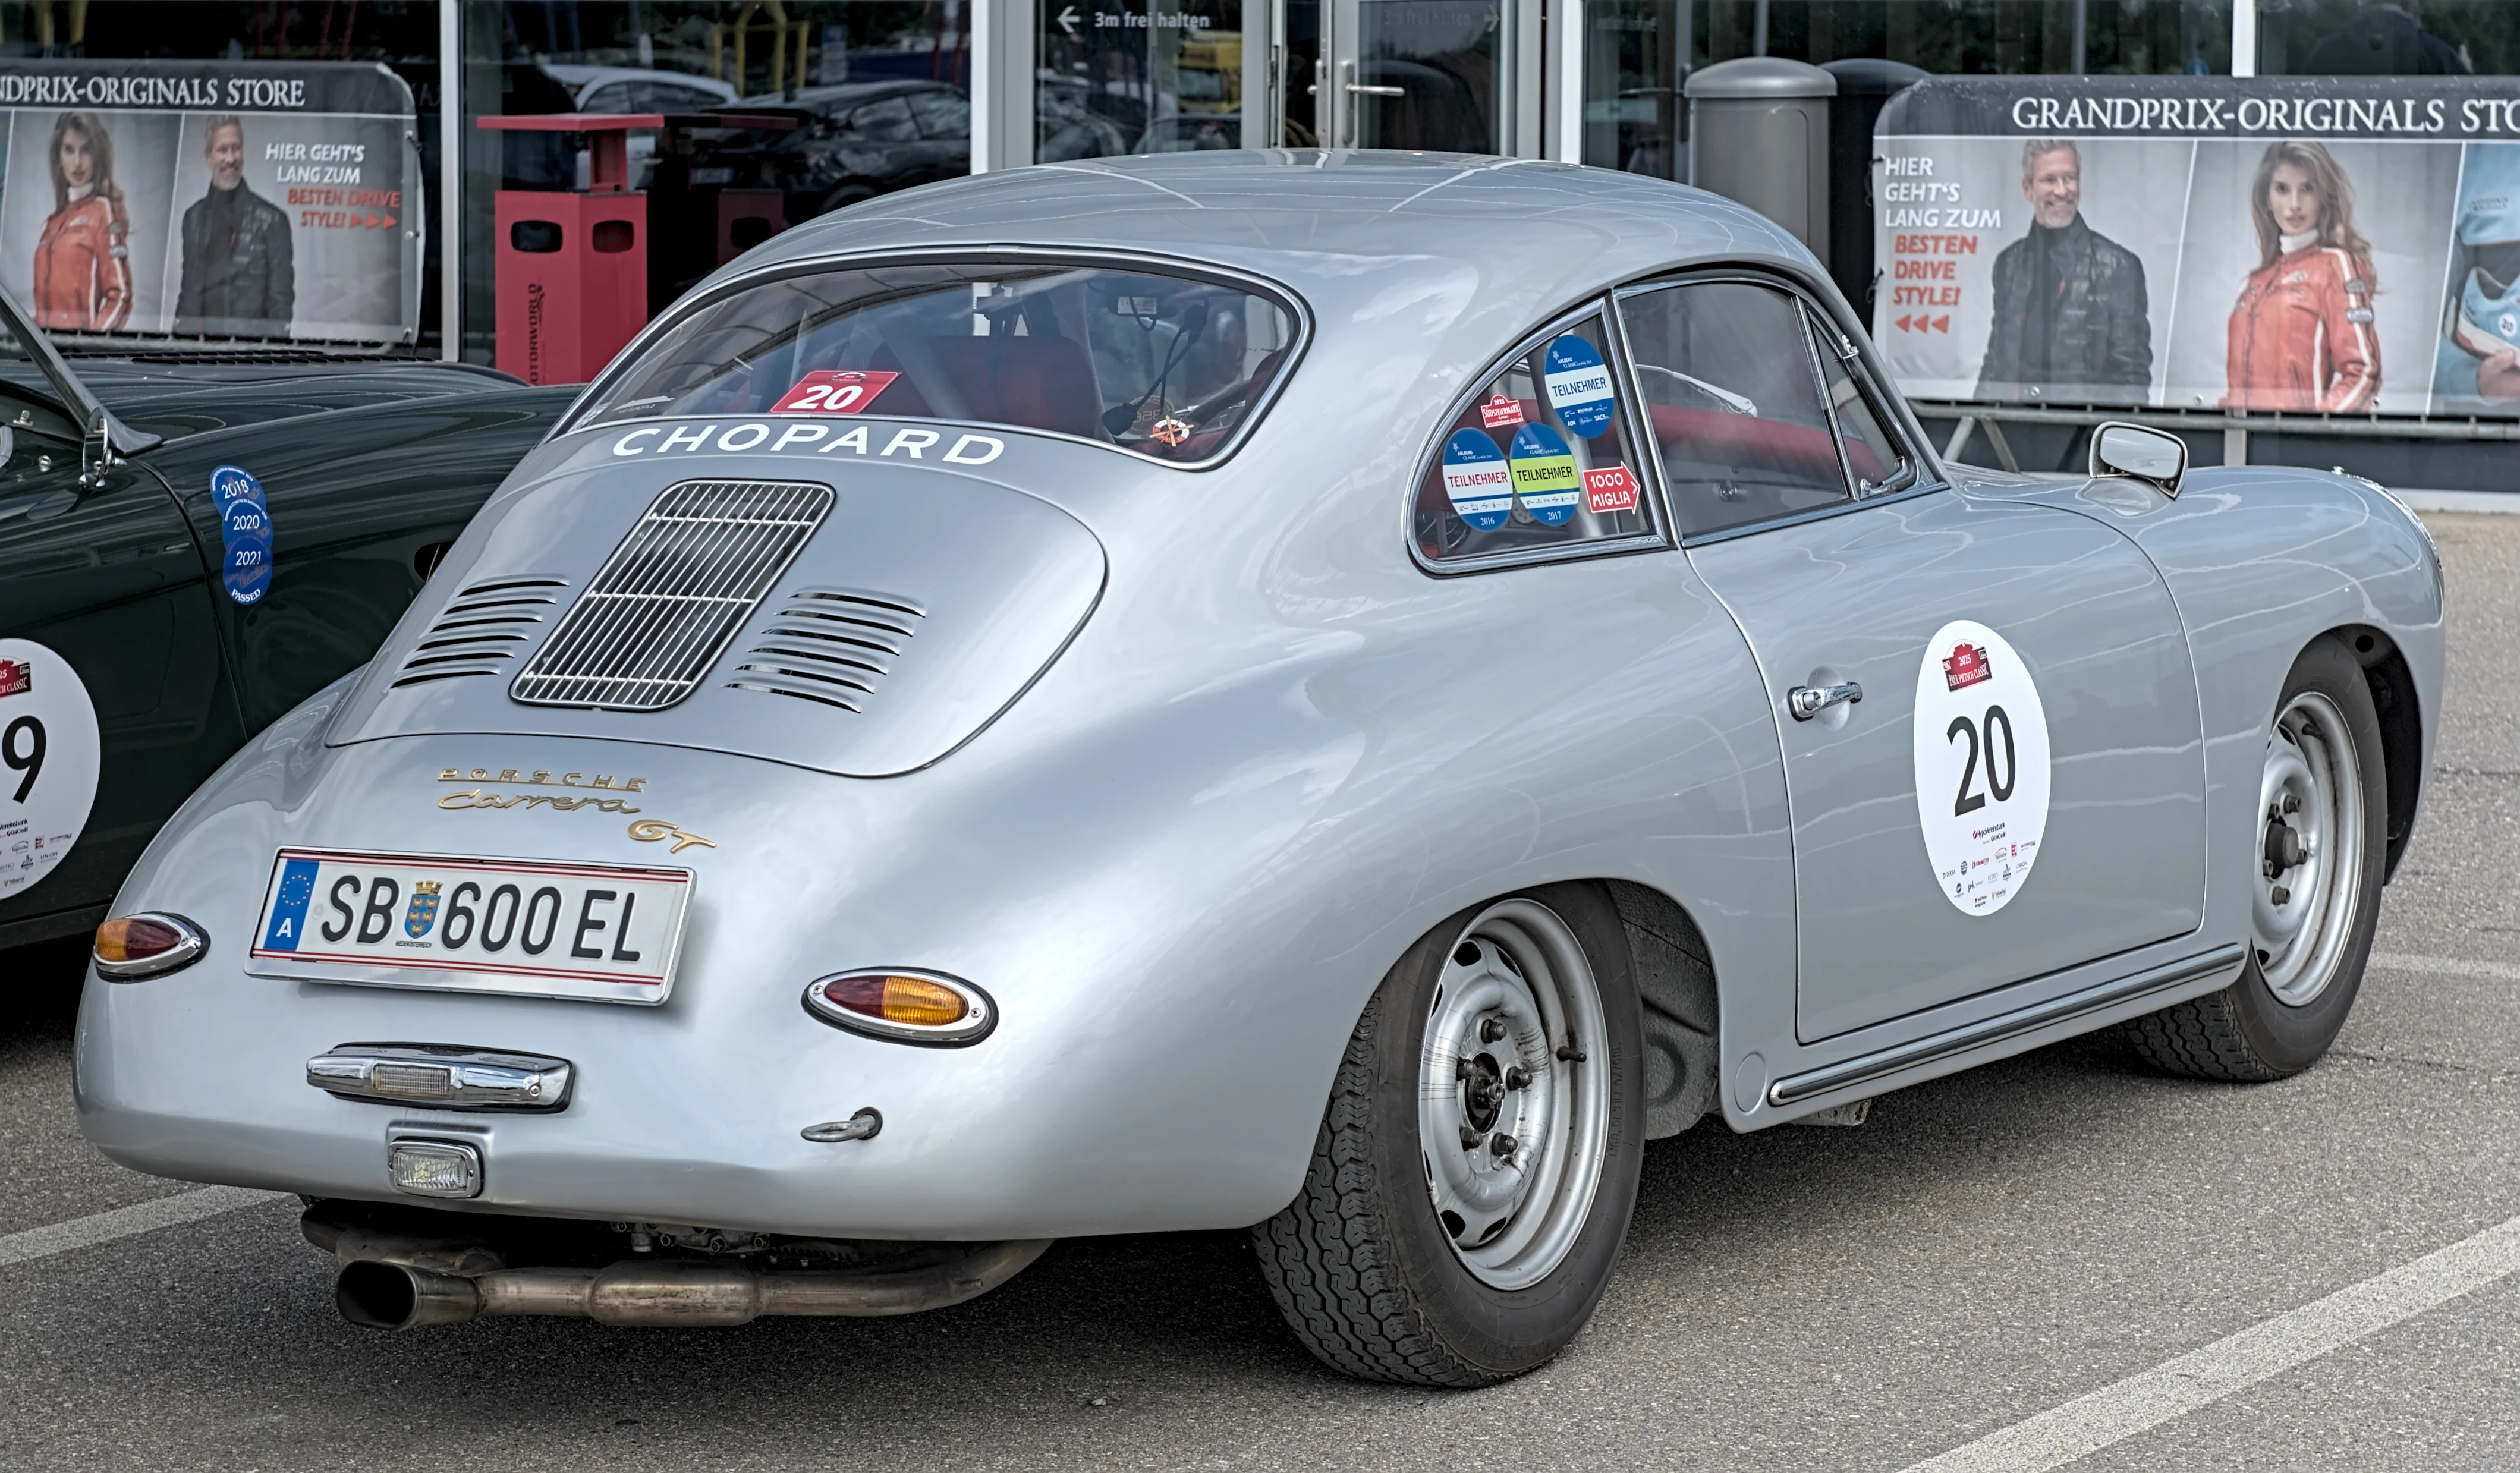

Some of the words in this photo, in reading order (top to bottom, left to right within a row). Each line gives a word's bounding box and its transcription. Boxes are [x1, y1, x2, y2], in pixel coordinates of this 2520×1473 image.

[1094, 11, 1119, 27] 3m
[1124, 11, 1152, 27] frei
[1157, 11, 1210, 27] halten
[226, 78, 306, 106] STORE
[2012, 97, 2445, 131] GRANDPRIX-ORIGINALS
[265, 143, 306, 161] HIER
[276, 165, 322, 183] LANG
[323, 166, 361, 185] ZUM
[1885, 157, 1934, 177] HIER
[288, 188, 344, 206] BESTEN
[347, 190, 402, 207] DRIVE
[300, 210, 347, 228] STYLE!
[1885, 209, 1939, 228] LANG
[1944, 209, 2002, 228] ZUM
[1895, 234, 1978, 255] BESTEN
[1895, 260, 1956, 280] DRIVE
[1893, 286, 1961, 307] STYLE!
[528, 284, 539, 385] OTORWORLD
[787, 385, 863, 410] 20
[1552, 377, 1607, 398] TEILNEHMER
[1483, 404, 1519, 418] SÜDSTEIERMARK
[612, 423, 1005, 465] CHOPARD
[1448, 471, 1508, 488] TEILNEHMER
[1516, 465, 1574, 482] TEILNEHMER
[1590, 473, 1624, 489] 1000
[221, 479, 249, 499] 2018
[1593, 490, 1631, 507] MIGLIA
[233, 514, 260, 530] 2020
[1480, 516, 1495, 526] 2016
[1547, 511, 1561, 521] 2017
[235, 550, 262, 565] 2021
[231, 588, 261, 602] PASSED
[1958, 653, 1972, 666] 2025
[1958, 671, 1975, 684] PIETSCH
[1973, 662, 1989, 679] CLASSIC
[7, 676, 27, 692] CLASSIC
[2, 715, 47, 804] 9
[1947, 704, 2016, 817] 20
[437, 768, 647, 792] PORSCHE
[437, 788, 641, 814] Carrera
[627, 819, 717, 854] GT
[40, 851, 58, 860] UNION
[276, 917, 292, 938] A
[321, 874, 400, 944] SB
[441, 881, 562, 956] 600
[570, 889, 641, 962] EL
[395, 940, 433, 948] NIEDERÖSTERREICH
